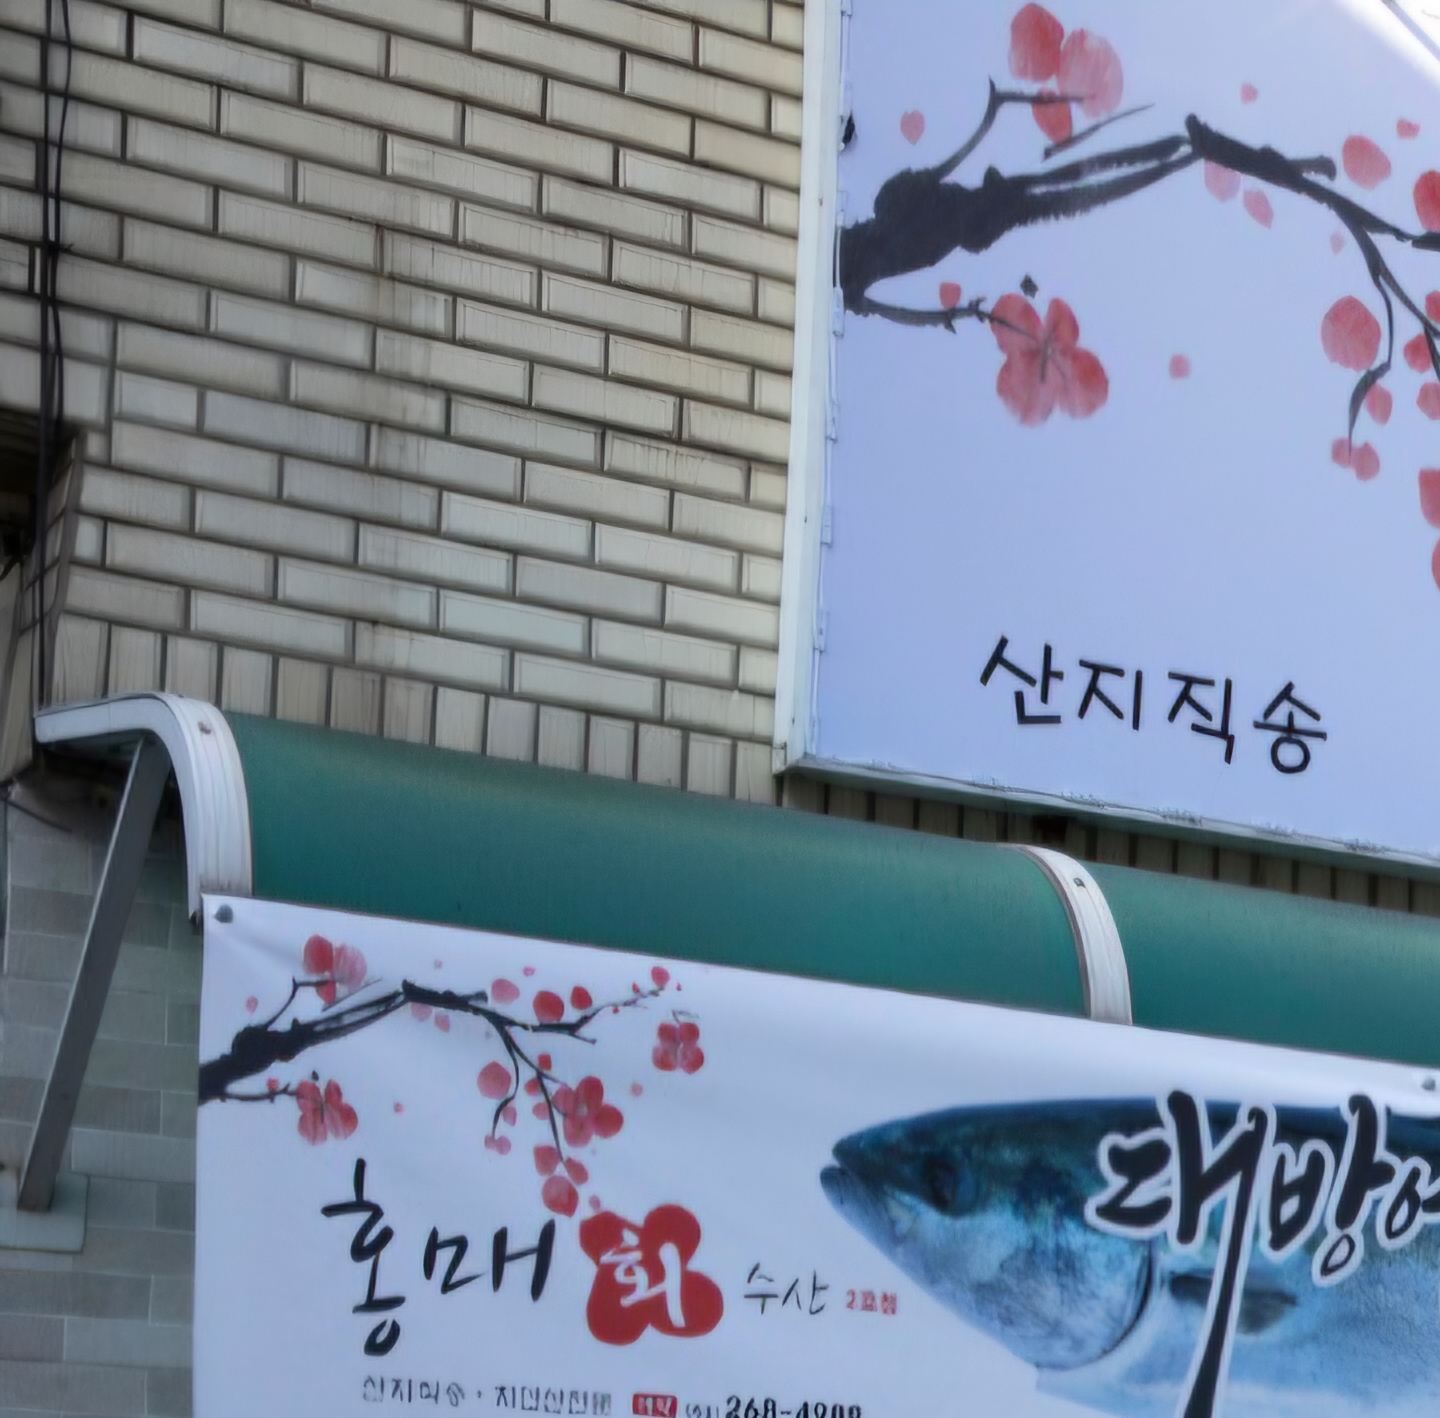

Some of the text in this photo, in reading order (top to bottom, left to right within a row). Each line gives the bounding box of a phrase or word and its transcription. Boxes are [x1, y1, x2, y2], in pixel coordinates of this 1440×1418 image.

[979, 635, 1328, 775] 산지직송
[320, 1157, 557, 1357] 홍매
[743, 1261, 830, 1316] 수산
